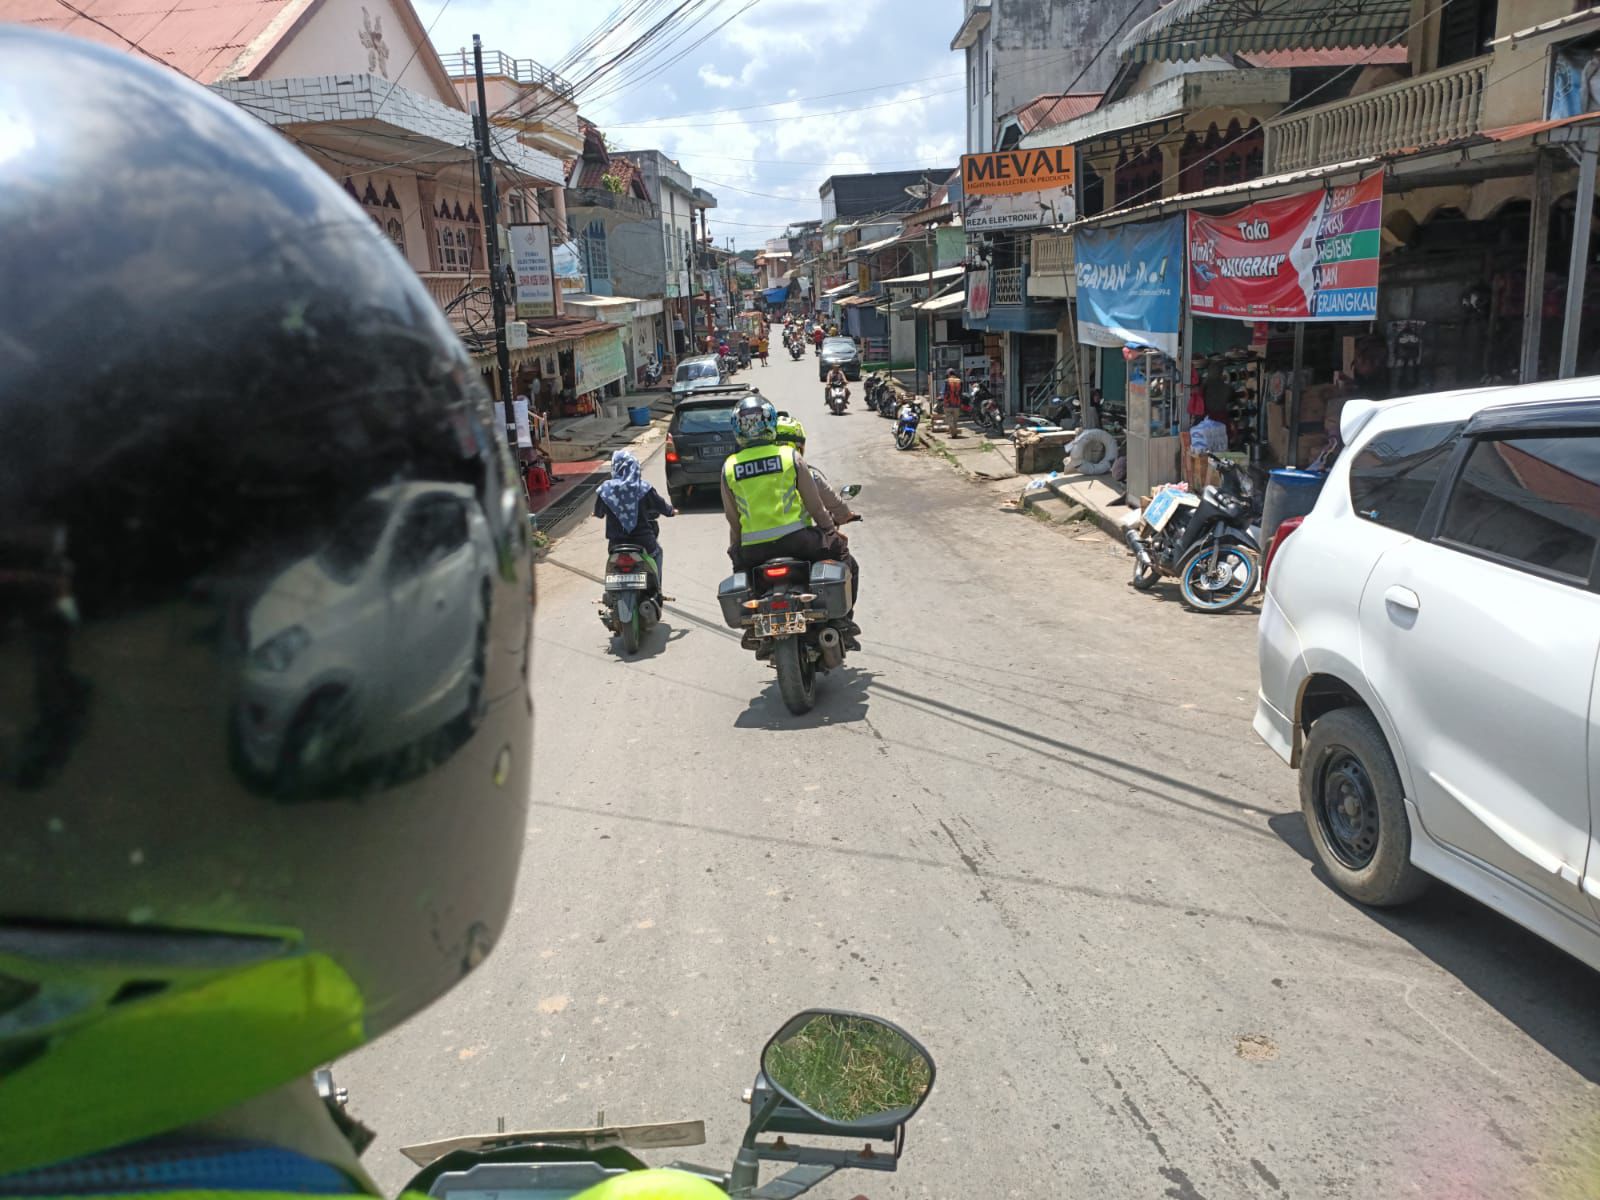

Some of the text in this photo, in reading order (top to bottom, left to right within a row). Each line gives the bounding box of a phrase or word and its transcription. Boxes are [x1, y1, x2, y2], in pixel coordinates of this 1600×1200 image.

[968, 150, 1070, 182] MEVAL
[967, 213, 1038, 226] REZA ELEKTRONIK
[1237, 219, 1270, 240] Toko
[735, 456, 781, 478] POLISI
